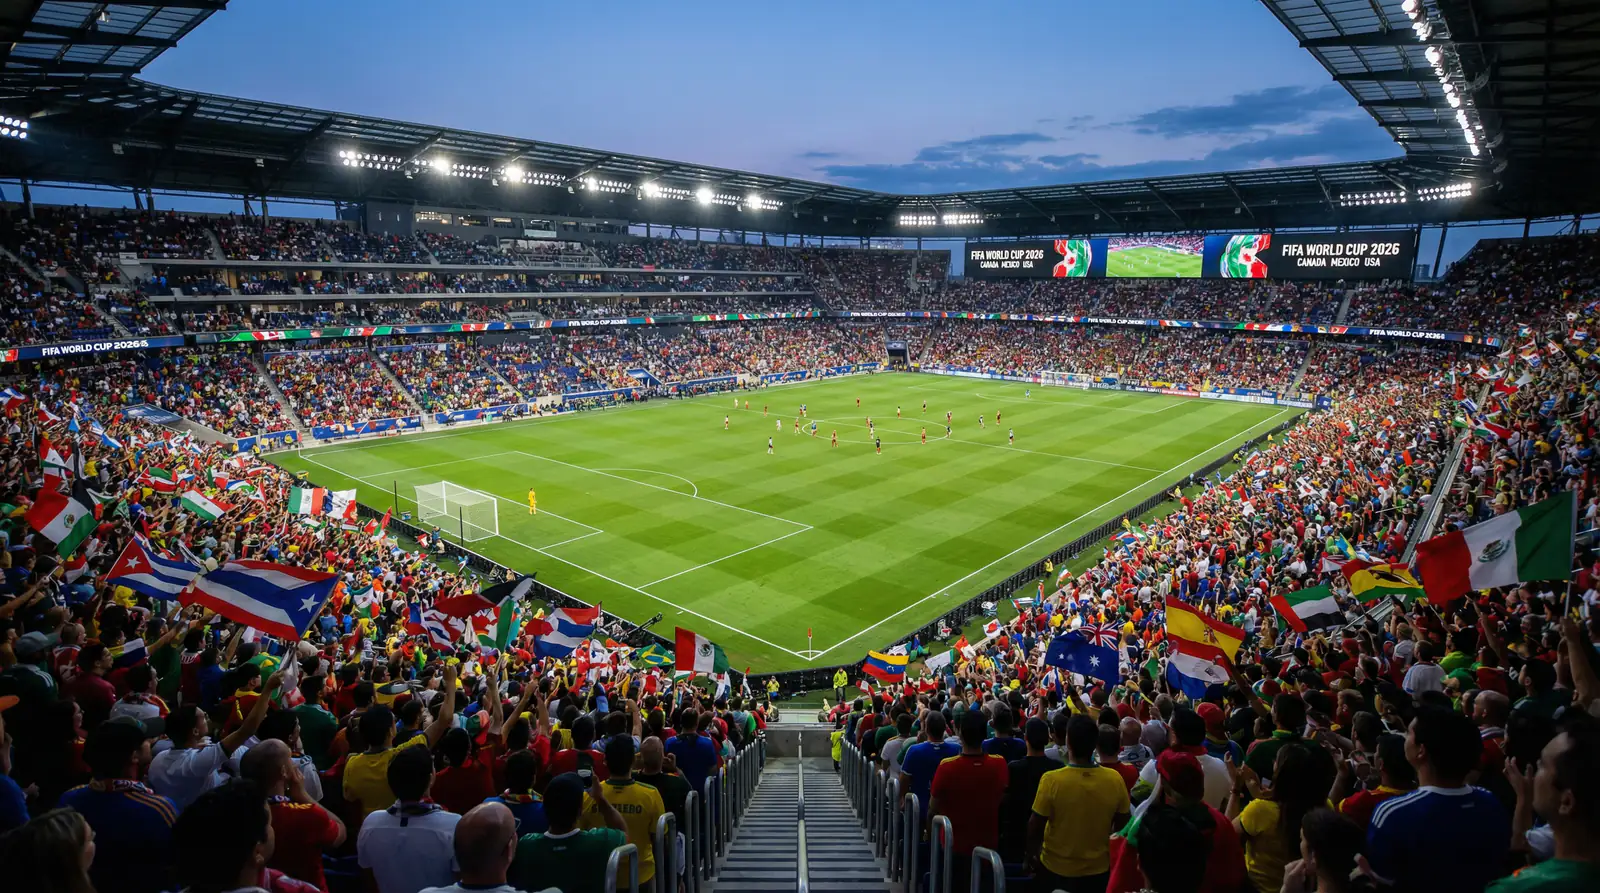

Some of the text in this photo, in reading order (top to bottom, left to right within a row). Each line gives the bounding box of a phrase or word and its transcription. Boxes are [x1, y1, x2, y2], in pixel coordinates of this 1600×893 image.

[971, 249, 1044, 260] FIFA WORLD CUP 2026
[1282, 243, 1400, 256] FIFA WORLD CUP 2026
[1022, 260, 1034, 269] USA
[1297, 257, 1380, 267] CANADA MEXICO USA
[1369, 328, 1386, 336] FIFA
[1386, 330, 1411, 338] WORLD
[42, 340, 140, 357] FIFA WORLD CUP 2026
